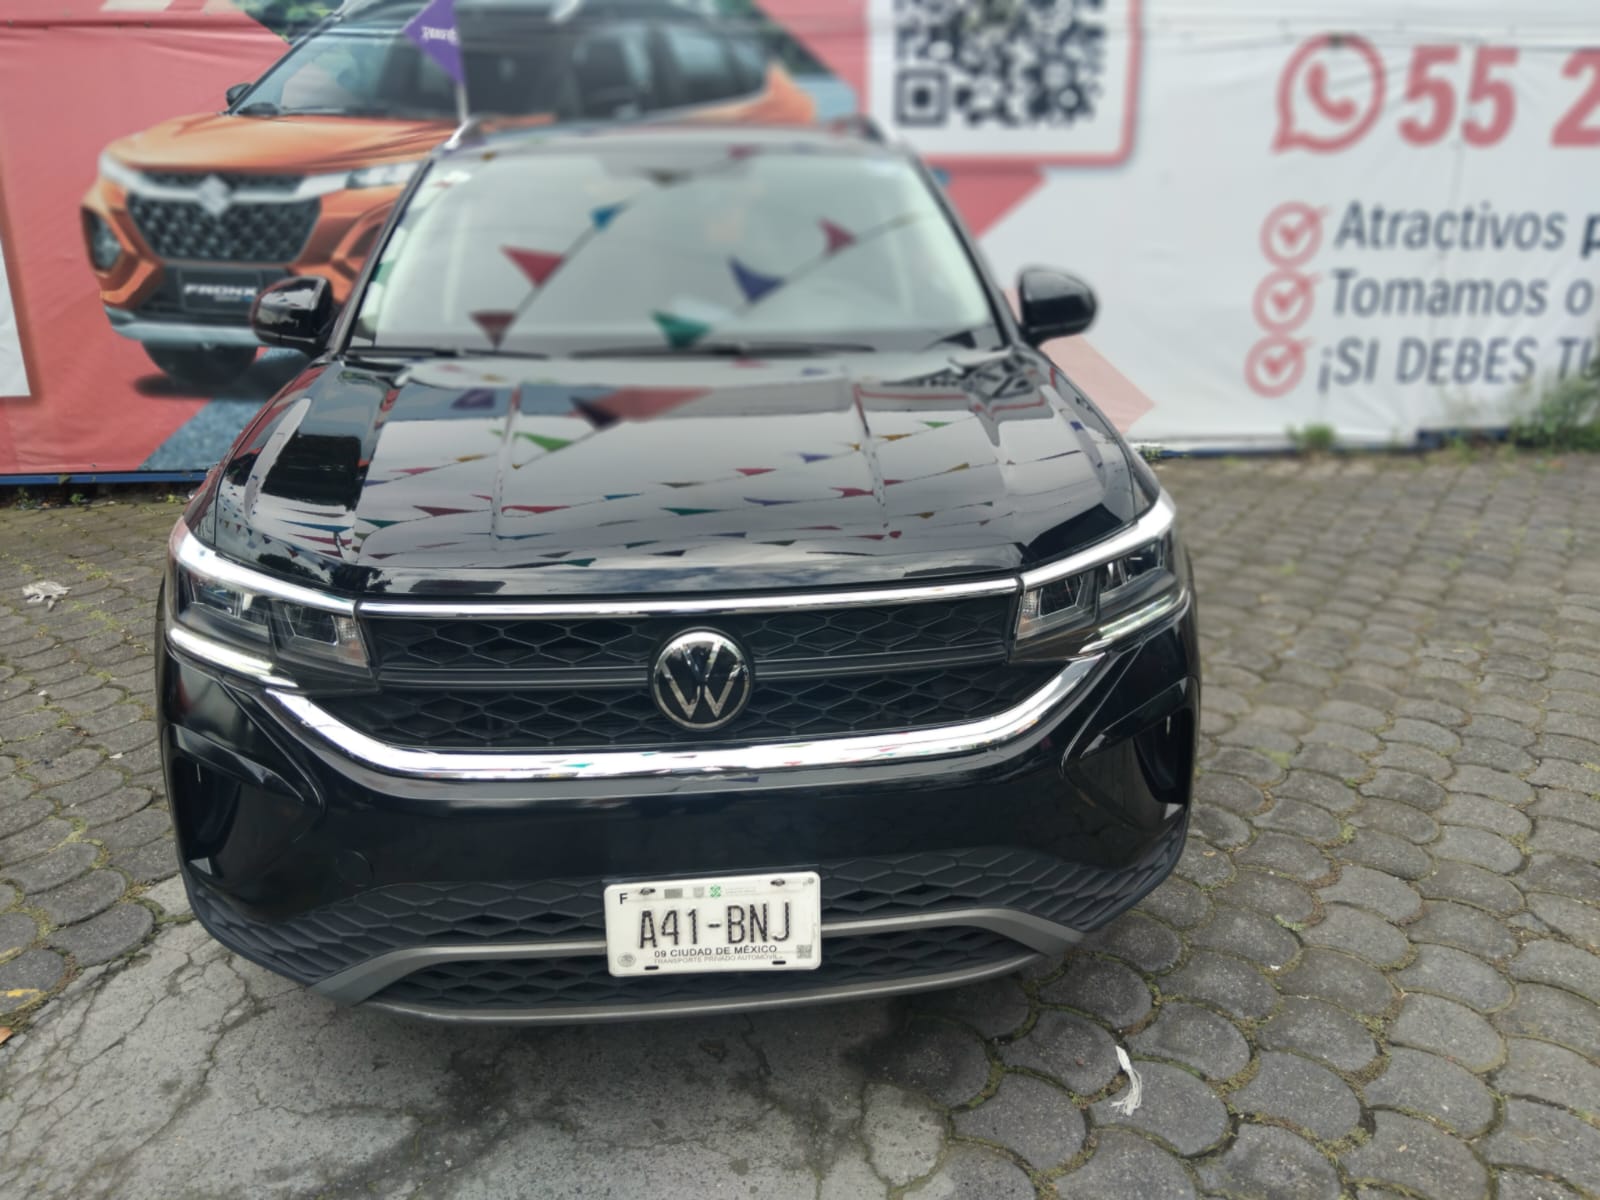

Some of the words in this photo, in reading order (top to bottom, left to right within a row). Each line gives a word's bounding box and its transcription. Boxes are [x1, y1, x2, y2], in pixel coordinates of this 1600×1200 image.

[1397, 44, 1520, 148] 55
[1550, 47, 1600, 148] 2
[1333, 200, 1567, 250] Atractivos
[1331, 268, 1549, 317] Tomamos
[1565, 278, 1594, 317] o
[1317, 337, 1381, 394] ¡SI
[1396, 338, 1538, 385] DEBES
[619, 893, 628, 905] F
[639, 901, 791, 949] A41-BNJ
[654, 950, 667, 958] 09
[670, 948, 712, 957] CIUDAD
[715, 946, 731, 955] DE
[734, 944, 777, 954] MÉXICO
